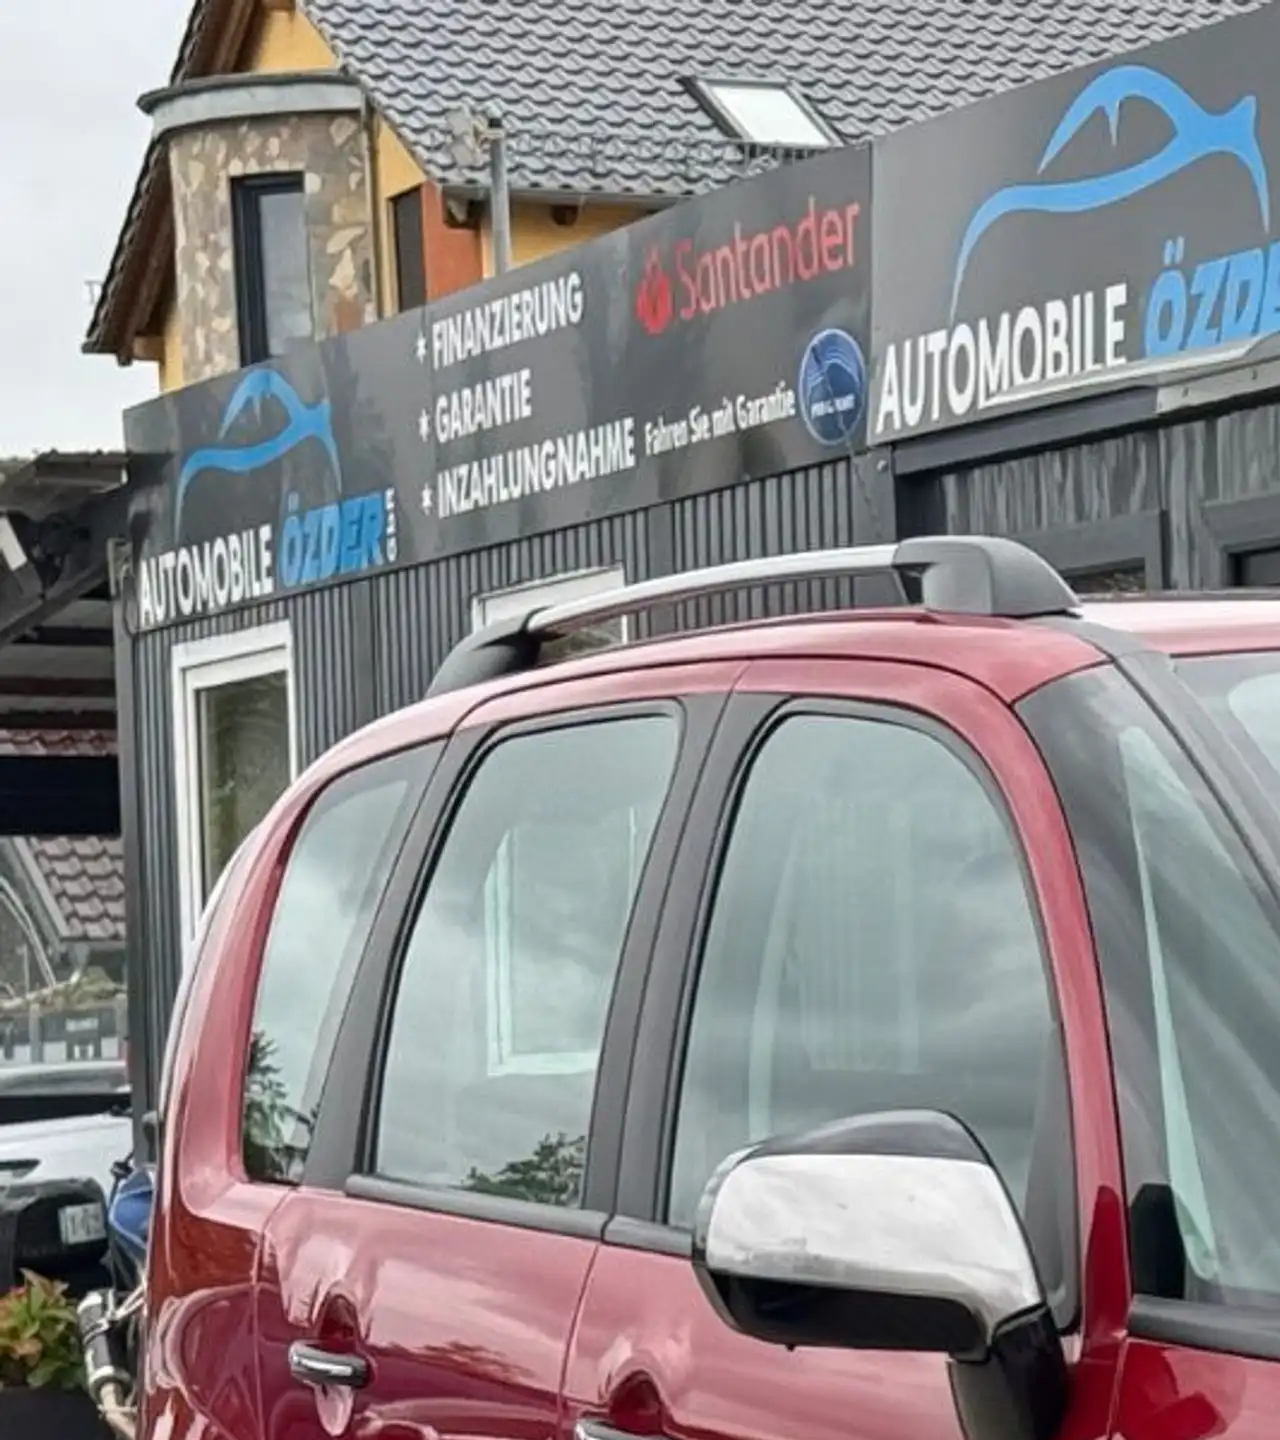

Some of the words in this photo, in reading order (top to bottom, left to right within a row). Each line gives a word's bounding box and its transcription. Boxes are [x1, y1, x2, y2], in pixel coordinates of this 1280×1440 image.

[674, 195, 860, 322] Santander
[432, 272, 584, 370] FINANZIERUNG
[875, 283, 1128, 433] AUTOMOBILE
[435, 368, 533, 443] GARANTIE
[644, 416, 689, 456] Fahren
[689, 405, 711, 443] Sie
[712, 396, 736, 438] mit
[736, 379, 797, 429] Garantie
[438, 416, 637, 519] INZAHLUNGNAHME
[139, 523, 275, 629] AUTOMOBILE
[280, 490, 385, 588] ÖZDER
